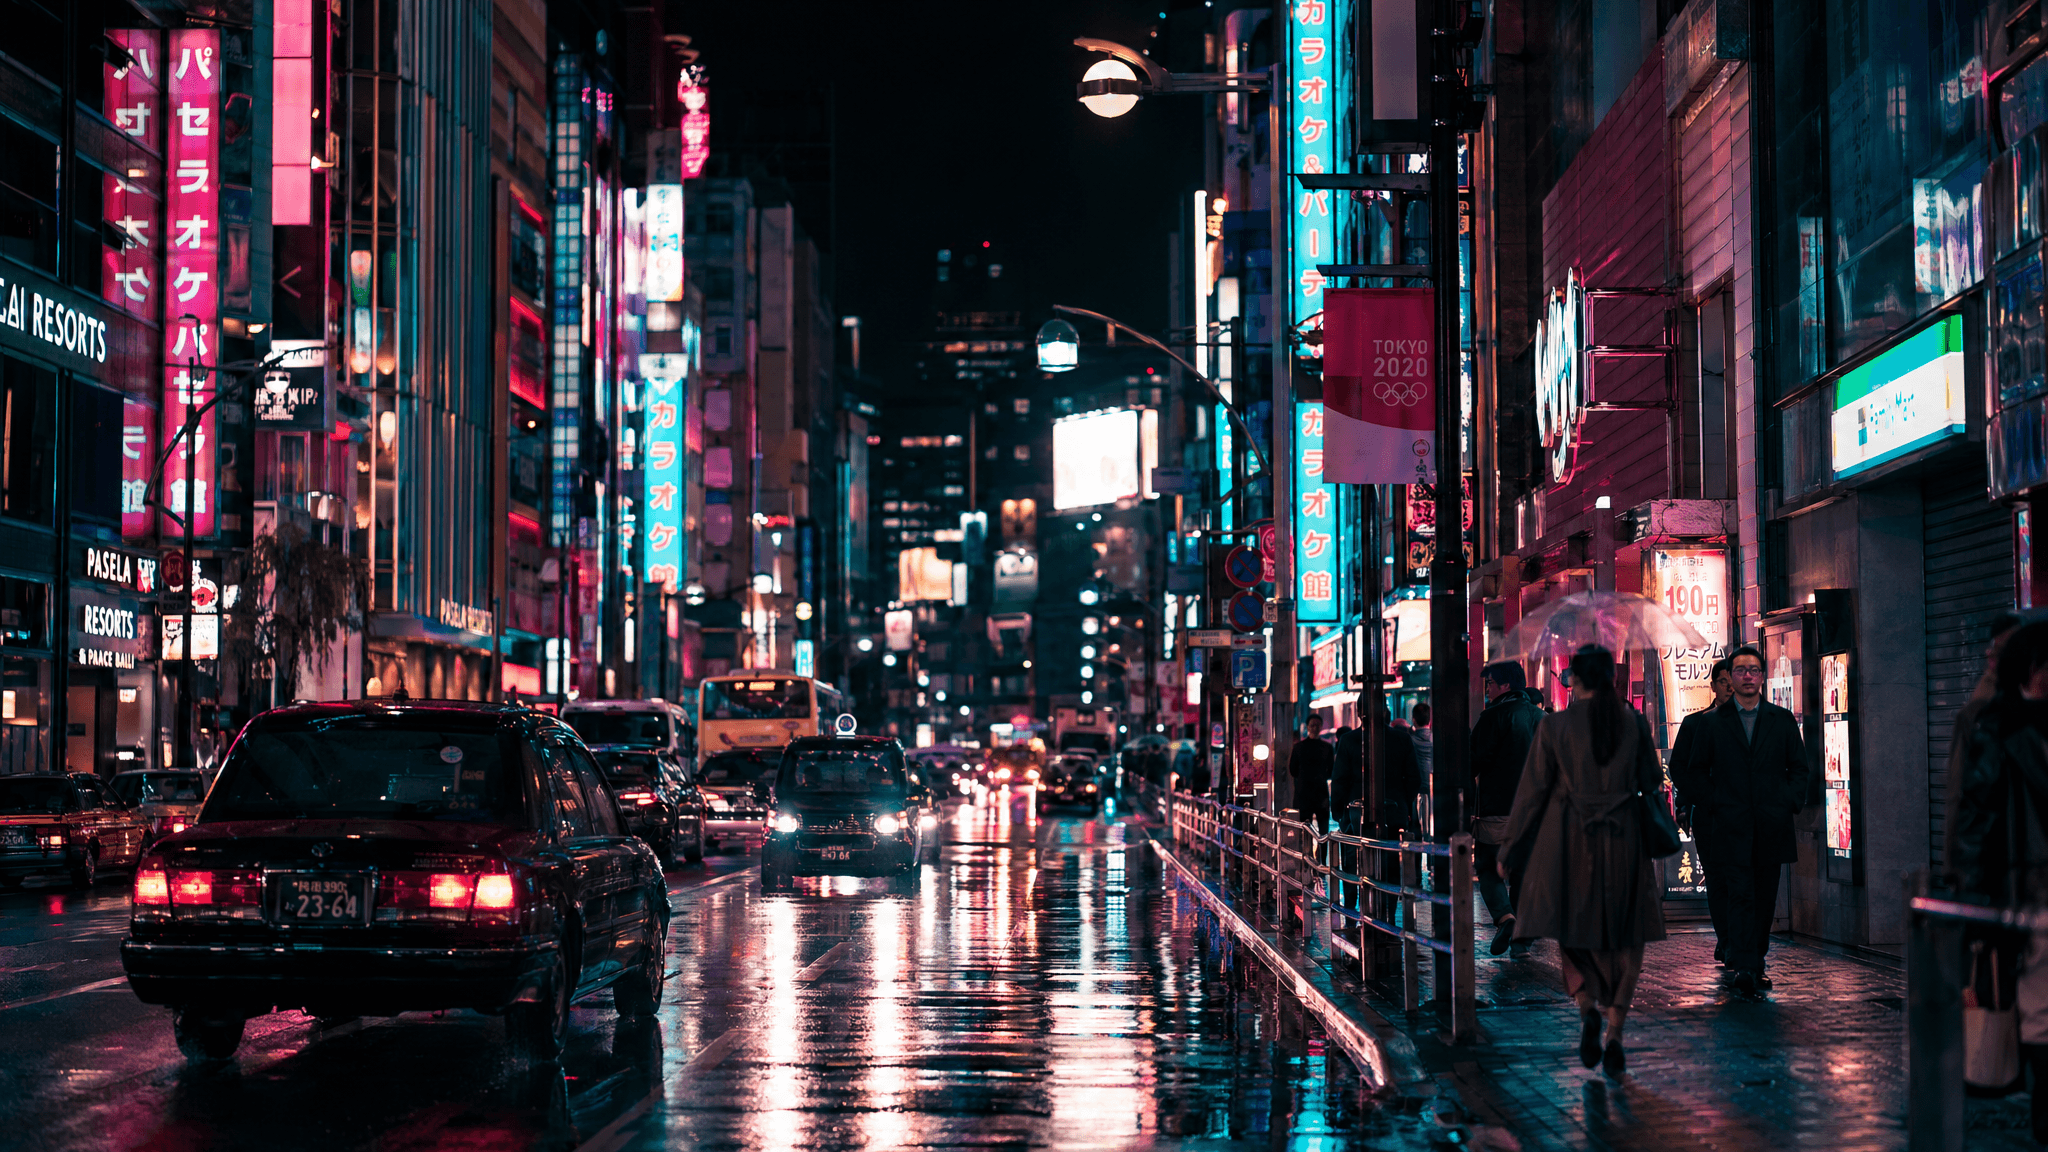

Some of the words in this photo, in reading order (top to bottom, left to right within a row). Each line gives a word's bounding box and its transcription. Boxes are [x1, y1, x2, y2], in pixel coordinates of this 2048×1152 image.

[32, 292, 106, 363] RESORTS
[1373, 339, 1428, 355] TOKYO
[1373, 357, 1428, 377] 2020
[649, 401, 678, 585] カラオケ館
[1302, 407, 1332, 601] カラオケ館
[87, 547, 132, 584] PASELA
[1665, 585, 1719, 616] 190円
[84, 604, 134, 640] RESORTS
[1239, 656, 1255, 682] P
[1674, 663, 1713, 681] モルツ
[296, 894, 358, 919] 23-64
